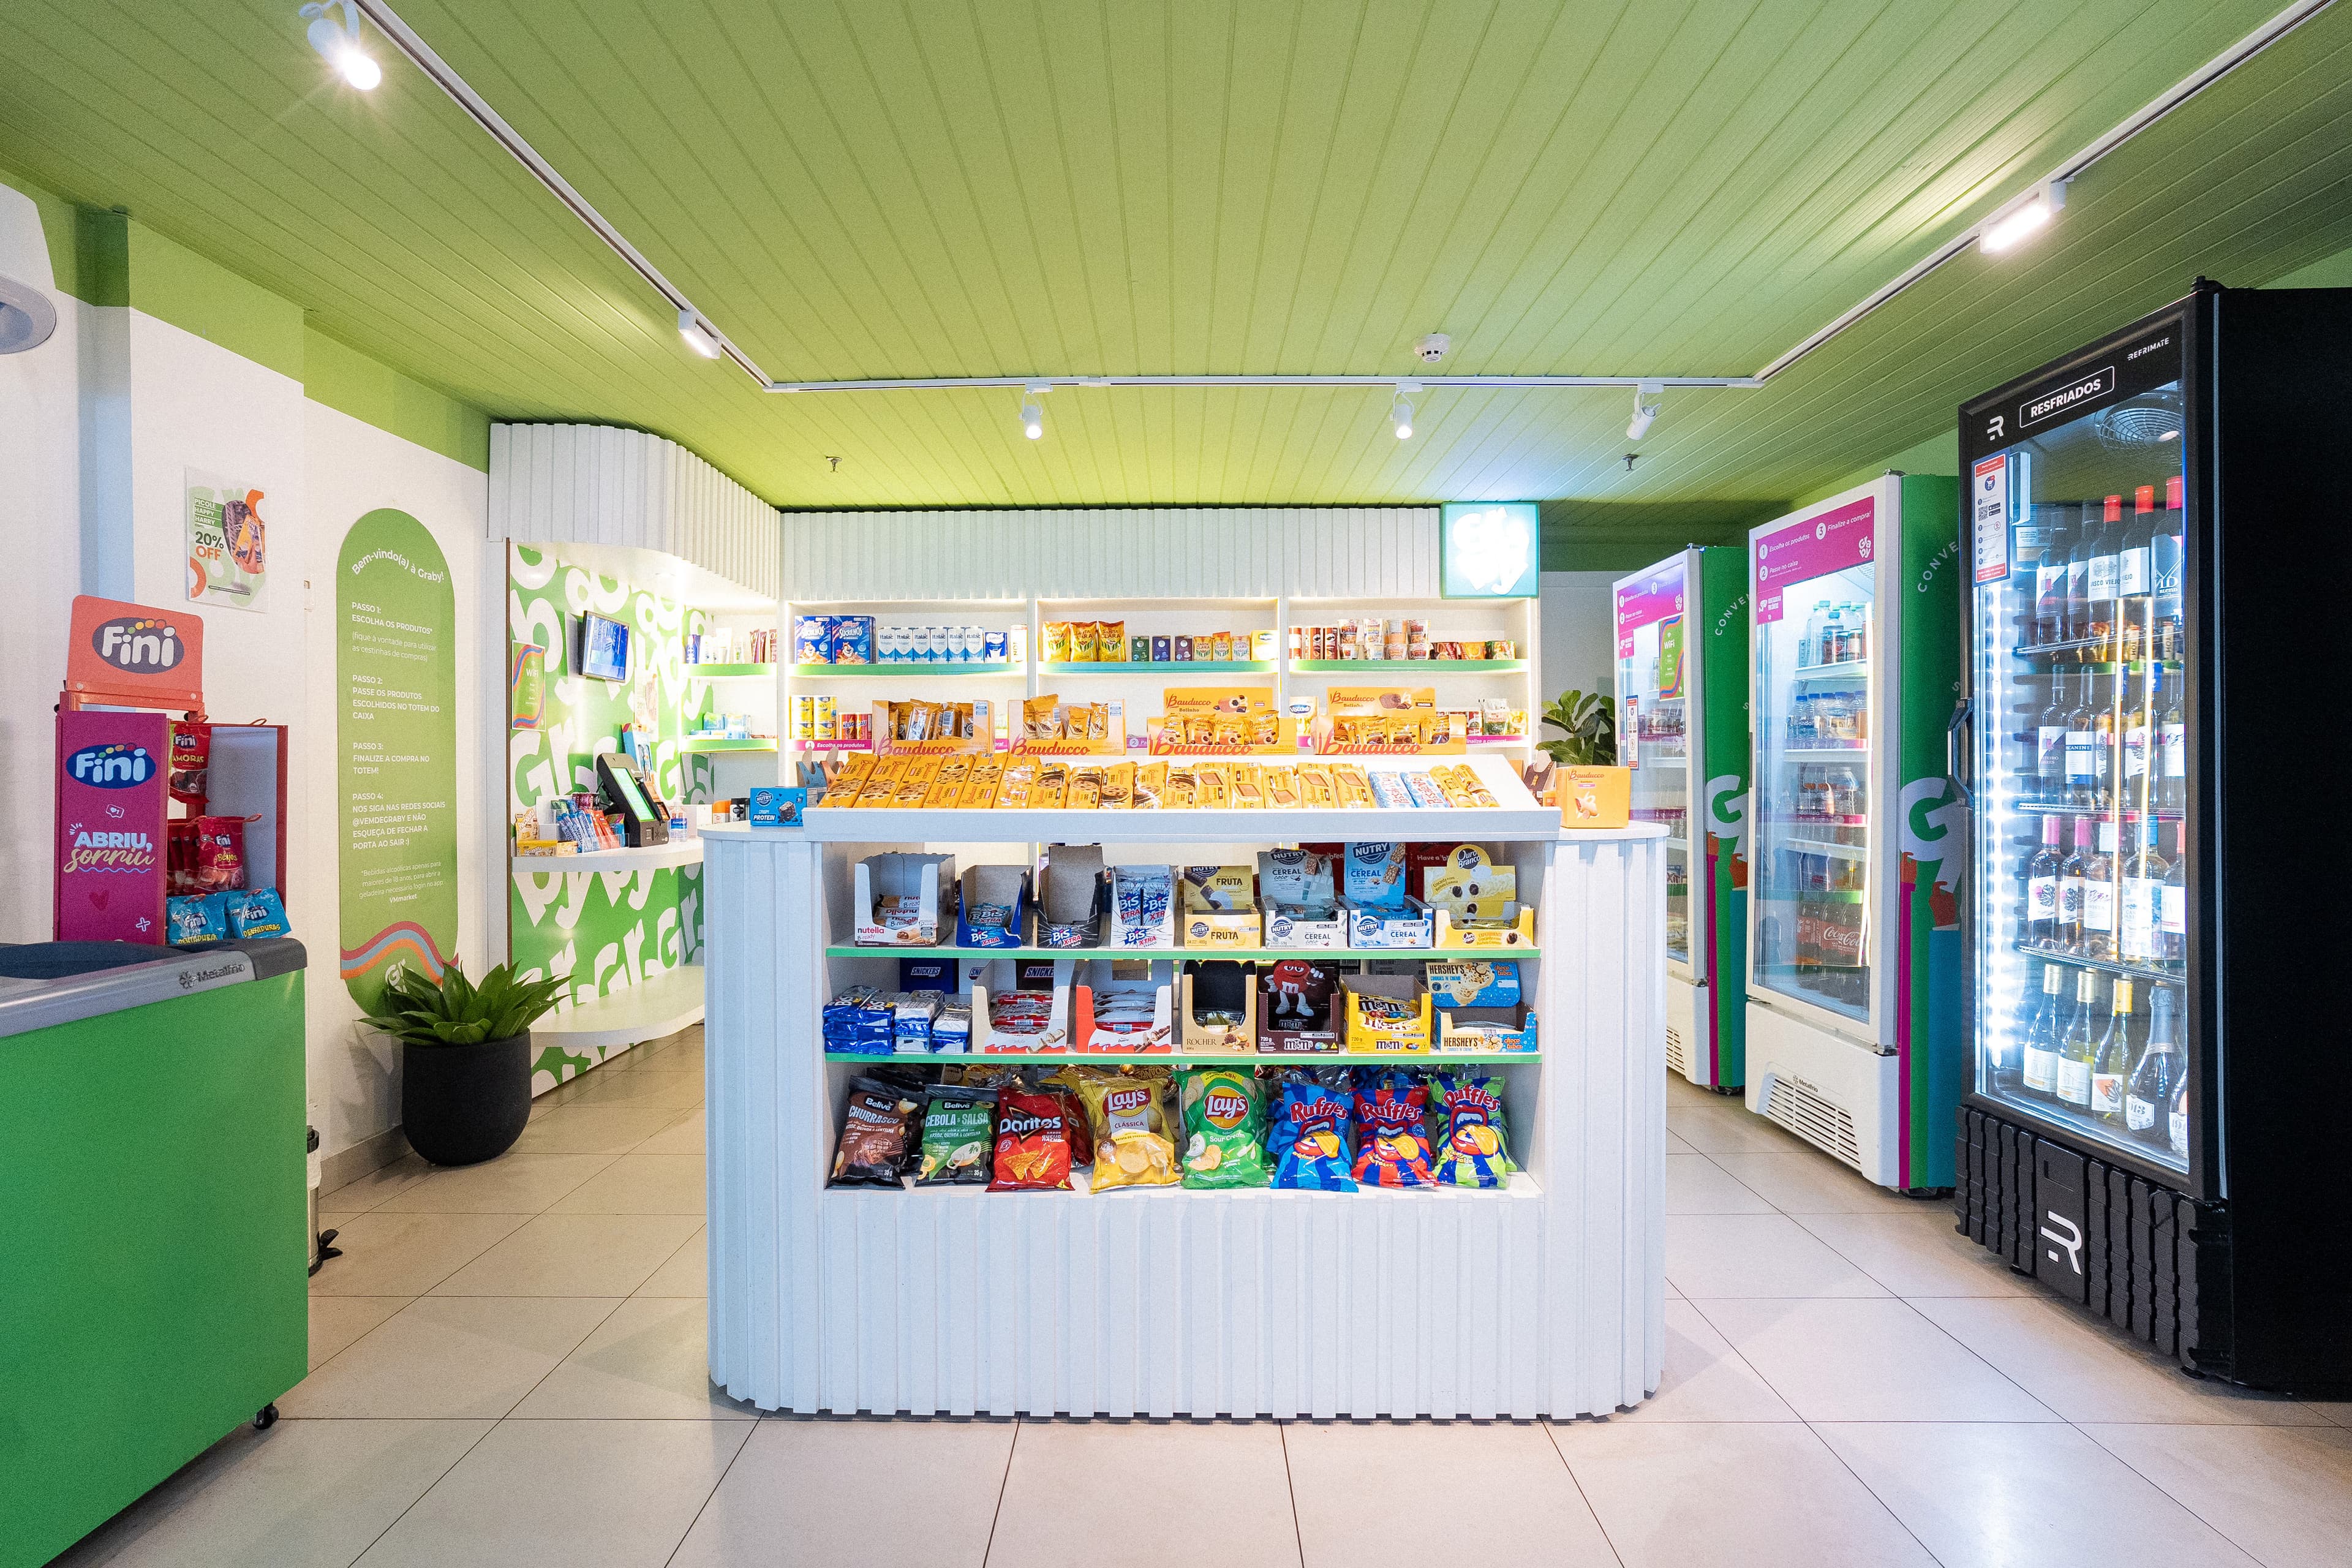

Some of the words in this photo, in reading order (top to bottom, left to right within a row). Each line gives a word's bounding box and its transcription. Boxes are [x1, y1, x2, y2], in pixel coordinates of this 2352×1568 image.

[2128, 337, 2169, 361] REFRIMATE
[2030, 379, 2101, 418] RESFRIADOS
[195, 507, 214, 516] HAPPY
[195, 515, 216, 525] HARRY
[1827, 520, 1845, 531] Finalize
[1851, 511, 1871, 524] compra!
[195, 531, 224, 549] 20%
[1770, 542, 1784, 552] Escolha
[1790, 533, 1810, 546] produtos
[195, 545, 222, 560] OFF
[352, 548, 409, 575] Bem-vindo(a)
[411, 564, 416, 574] à
[418, 568, 444, 582] Graby!
[352, 602, 375, 612] PASSO
[352, 614, 384, 626] ESCOLHA
[102, 625, 176, 667] Fini
[352, 631, 371, 641] (fique
[378, 637, 402, 646] vontade
[418, 643, 436, 652] utilizar
[1664, 639, 1675, 649] WiFi
[361, 646, 391, 655] cestinhas
[401, 652, 428, 662] compras)
[353, 674, 375, 683] PASSO
[526, 668, 538, 677] WiFi
[353, 687, 374, 696] PASSE
[387, 691, 422, 699] PRODUTOS
[1330, 691, 1375, 704] Bauducco
[353, 699, 396, 709] ESCOLHIDOS
[1166, 693, 1212, 708] Bauducco
[874, 734, 956, 756] Bauducco
[1010, 734, 1091, 755] Bauducco
[75, 748, 146, 782] Fini
[172, 754, 204, 763] AMORAS
[1568, 769, 1604, 780] Bauducco
[353, 815, 405, 827] @VEMDEGRABY
[353, 829, 385, 838] ESQUEÇA
[74, 832, 153, 853] ABRIU,
[353, 842, 377, 850] PORTA
[1273, 851, 1304, 860] NUTRY
[1354, 844, 1388, 856] NUTRY
[1457, 849, 1477, 861] Ouro
[64, 848, 156, 873] sorriu
[217, 853, 238, 862] Beijos
[1458, 856, 1480, 869] Branco
[362, 878, 384, 887] maiores
[359, 888, 385, 899] geladeira
[390, 894, 417, 903] VMmarket
[1357, 923, 1378, 932] NUTRY
[1823, 926, 1860, 946] Coca-Co
[197, 963, 244, 981] Metalfrio
[1430, 965, 1464, 974] HERSHEY'S
[1444, 1038, 1478, 1046] HERSHEY'S
[1799, 1079, 1818, 1092] Metalfrio
[1108, 1089, 1148, 1111] Lay's
[1443, 1085, 1500, 1112] Ruffles
[1207, 1096, 1246, 1119] Lay's
[1290, 1097, 1348, 1123] Ruffles
[1361, 1099, 1422, 1121] Ruffles
[849, 1106, 900, 1123] CHURRASCO
[925, 1114, 956, 1127] CEBOLA
[962, 1113, 989, 1125] SALSA
[1000, 1117, 1061, 1134] Doritos
